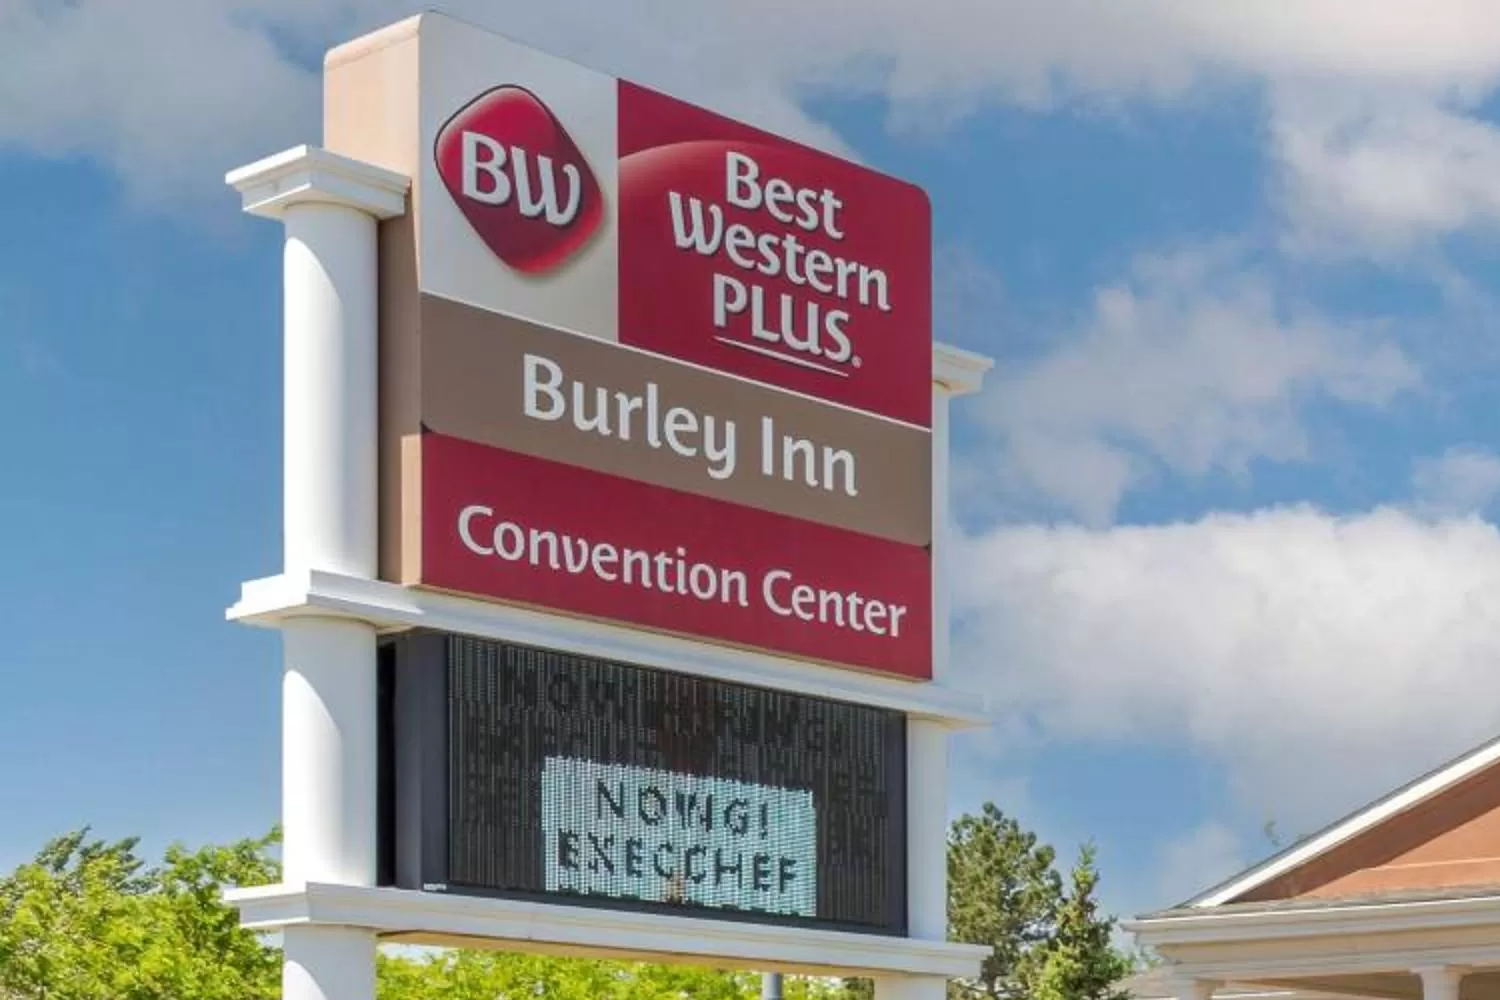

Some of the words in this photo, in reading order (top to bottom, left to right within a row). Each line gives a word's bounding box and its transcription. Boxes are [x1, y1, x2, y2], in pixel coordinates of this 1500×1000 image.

[460, 130, 582, 227] BW
[725, 150, 844, 240] Best
[668, 190, 891, 312] Western
[522, 353, 736, 480] Burley
[761, 416, 859, 497] Inn
[456, 505, 749, 607] Convention
[761, 569, 907, 638] Center
